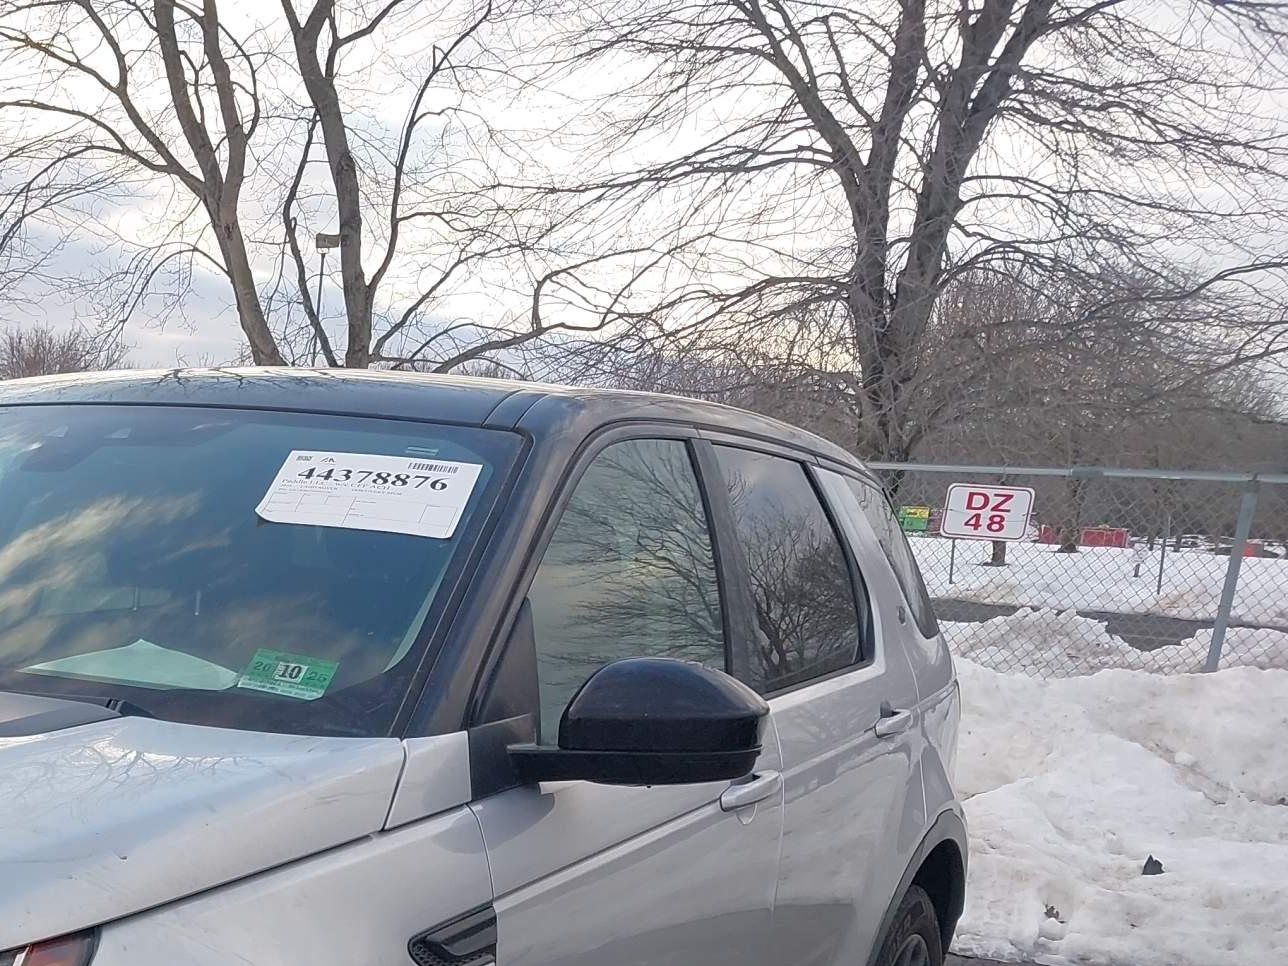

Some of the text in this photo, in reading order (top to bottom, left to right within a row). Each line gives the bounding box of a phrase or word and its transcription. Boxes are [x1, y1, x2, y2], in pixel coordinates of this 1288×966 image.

[297, 466, 450, 491] 44378876
[965, 491, 1015, 513] DZ
[964, 513, 1006, 533] 48
[278, 663, 302, 680] 10
